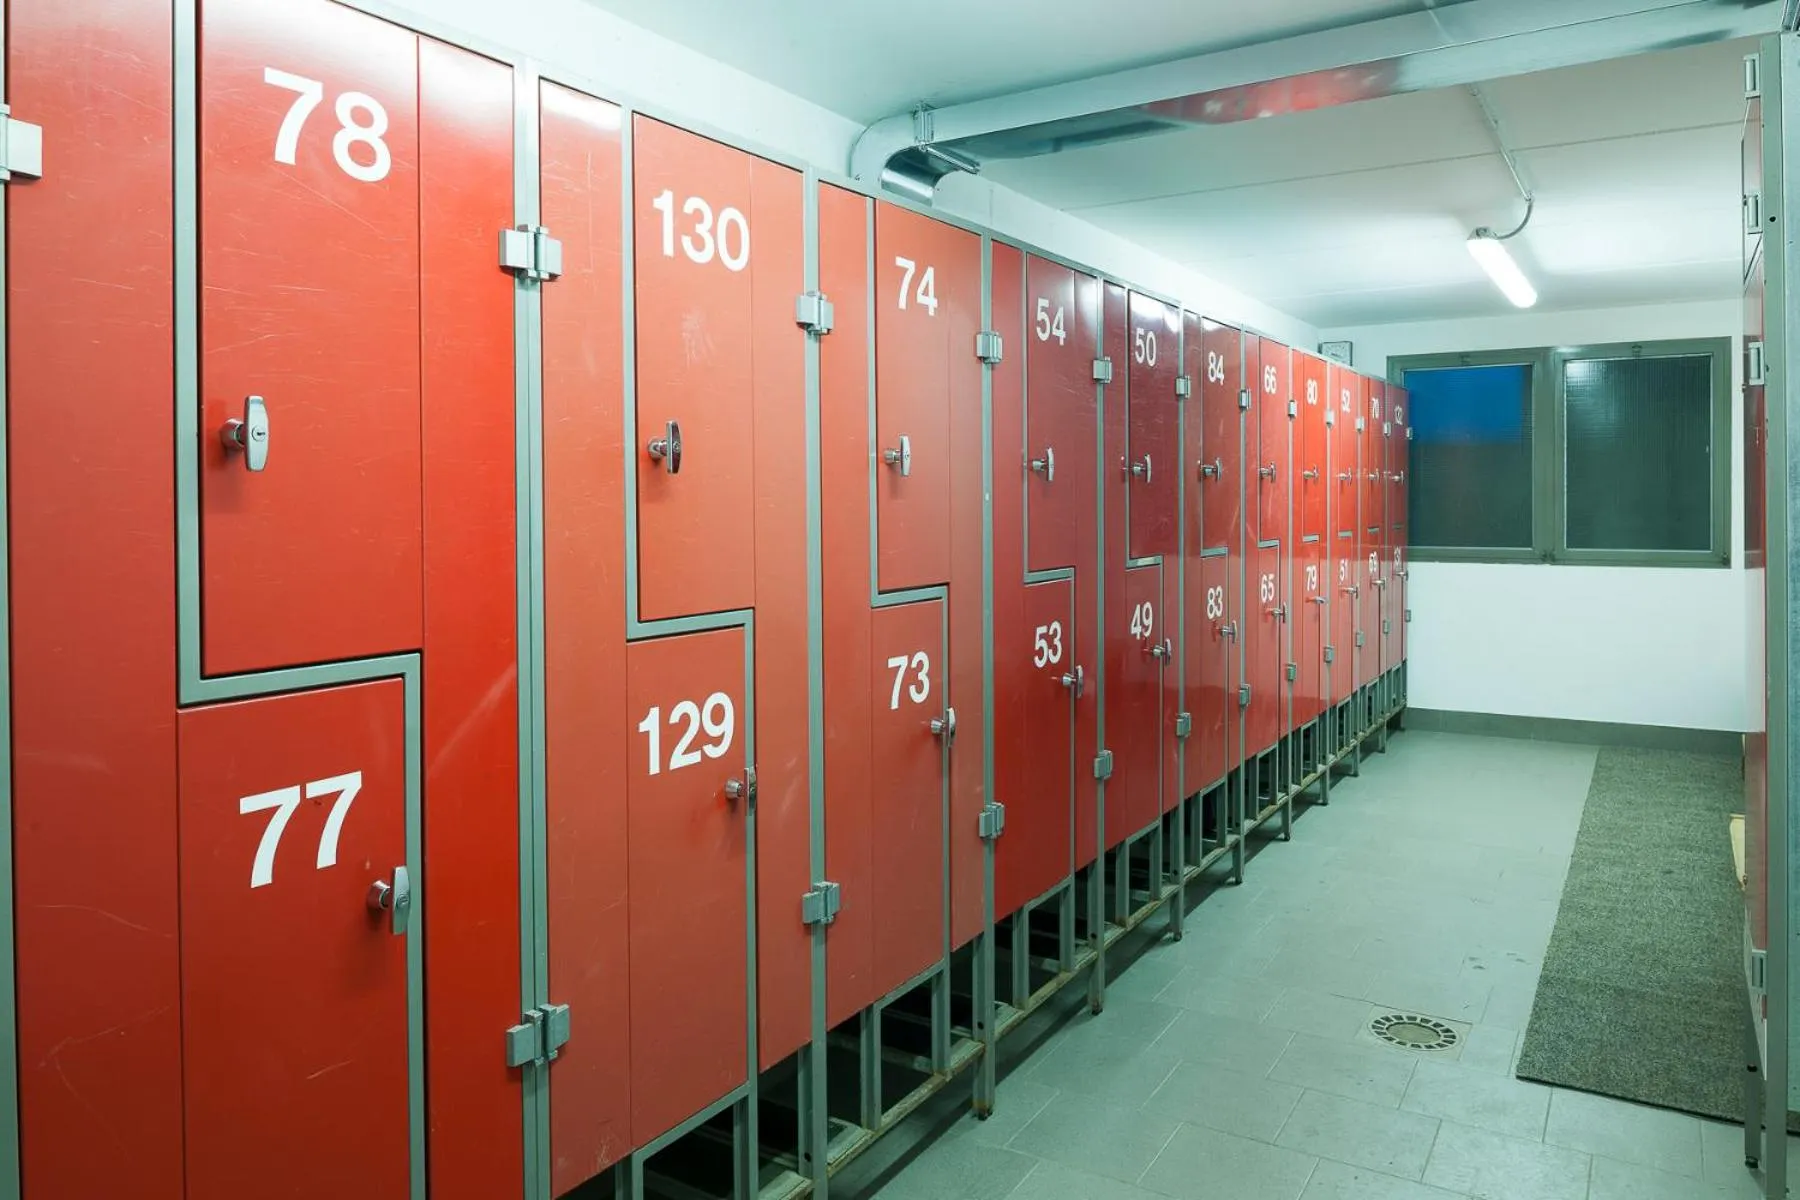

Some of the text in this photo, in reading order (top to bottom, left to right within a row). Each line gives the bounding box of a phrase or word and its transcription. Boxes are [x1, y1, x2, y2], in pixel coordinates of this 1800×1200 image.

[263, 66, 392, 182] 78
[653, 190, 749, 271] 130
[896, 257, 937, 316] 74
[1036, 297, 1066, 345] 54
[1135, 327, 1156, 366] 50
[1209, 351, 1224, 384] 84
[1265, 365, 1276, 393] 66
[1307, 380, 1317, 404] 80
[1342, 389, 1351, 412] 52
[1261, 574, 1274, 602] 65
[1307, 566, 1317, 591] 79
[1339, 560, 1348, 581] 51
[1131, 602, 1152, 639] 49
[1207, 586, 1222, 619] 83
[1035, 621, 1061, 667] 53
[888, 652, 929, 709] 73
[639, 692, 734, 775] 129
[240, 771, 361, 888] 77
